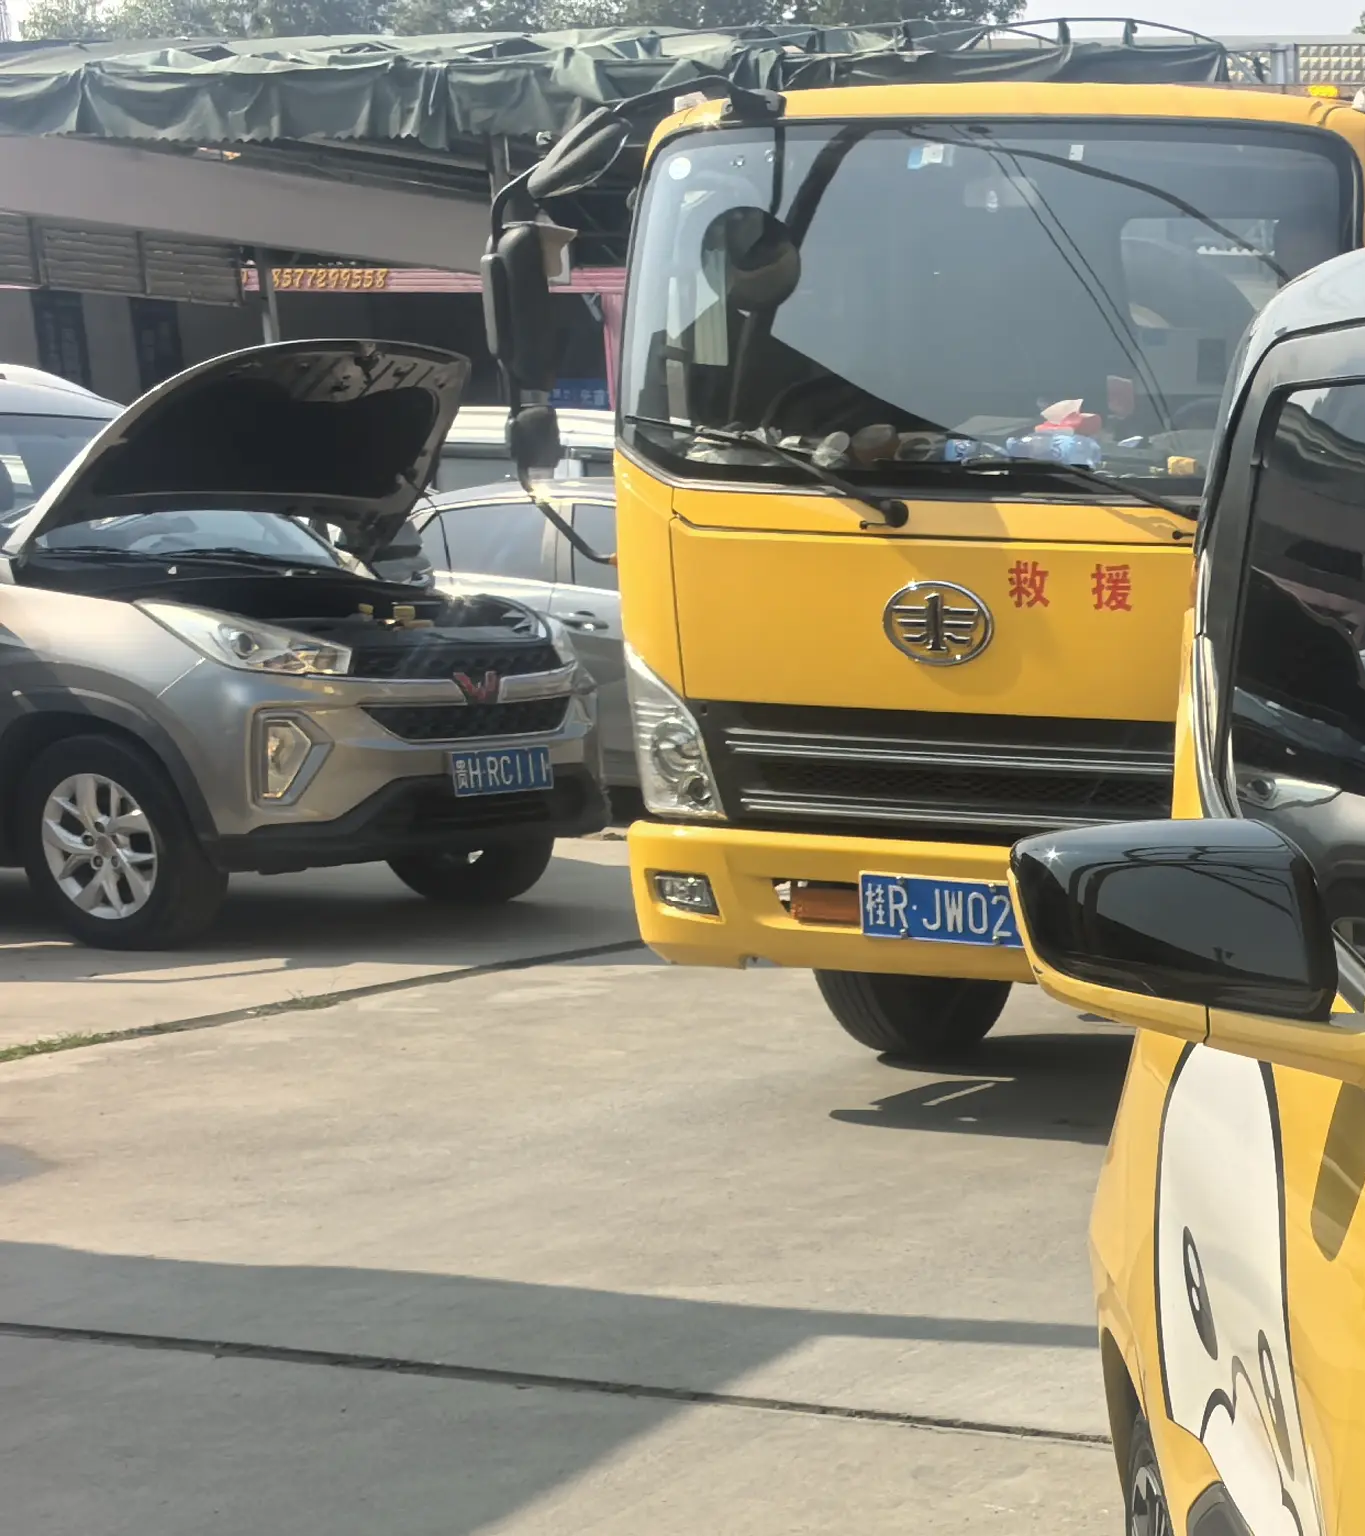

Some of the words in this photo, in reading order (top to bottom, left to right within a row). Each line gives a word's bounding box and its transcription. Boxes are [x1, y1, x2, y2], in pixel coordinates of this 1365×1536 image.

[272, 268, 388, 290] 8577299558
[1008, 561, 1132, 612] 救援
[865, 883, 1012, 938] 桂R·JW02
